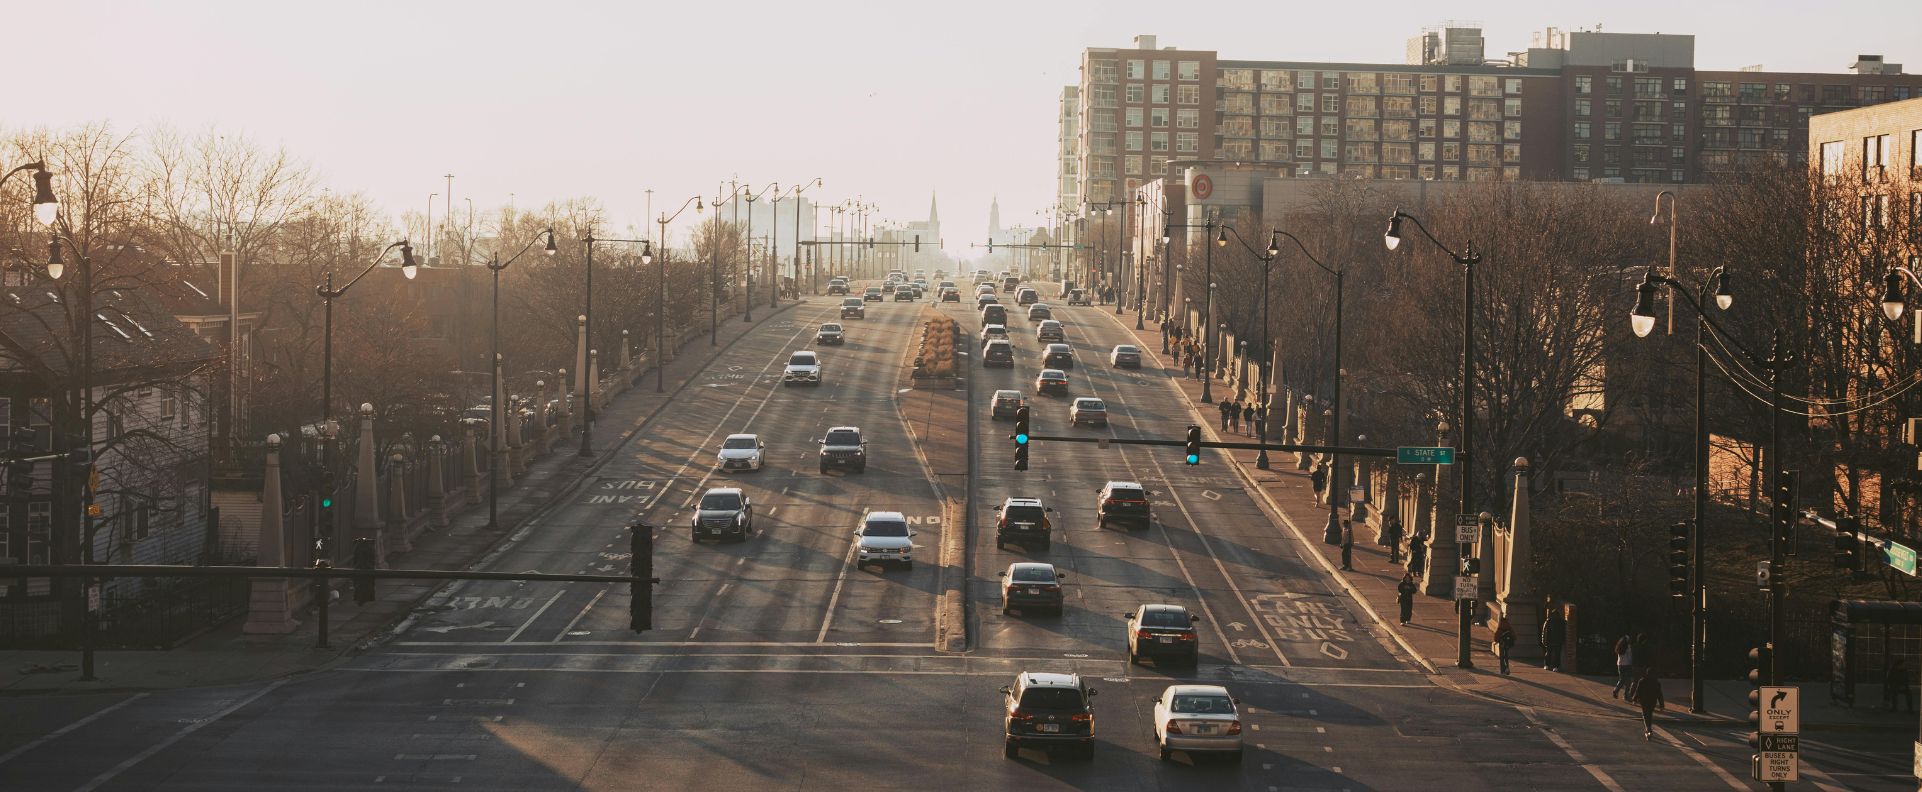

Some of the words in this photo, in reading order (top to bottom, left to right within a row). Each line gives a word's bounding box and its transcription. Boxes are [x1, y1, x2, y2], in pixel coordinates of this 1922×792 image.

[602, 480, 656, 489] BUS
[906, 515, 941, 525] ON
[1264, 614, 1344, 629] ONLY
[1274, 626, 1355, 641] BUS
[1771, 771, 1788, 779] ONLY
